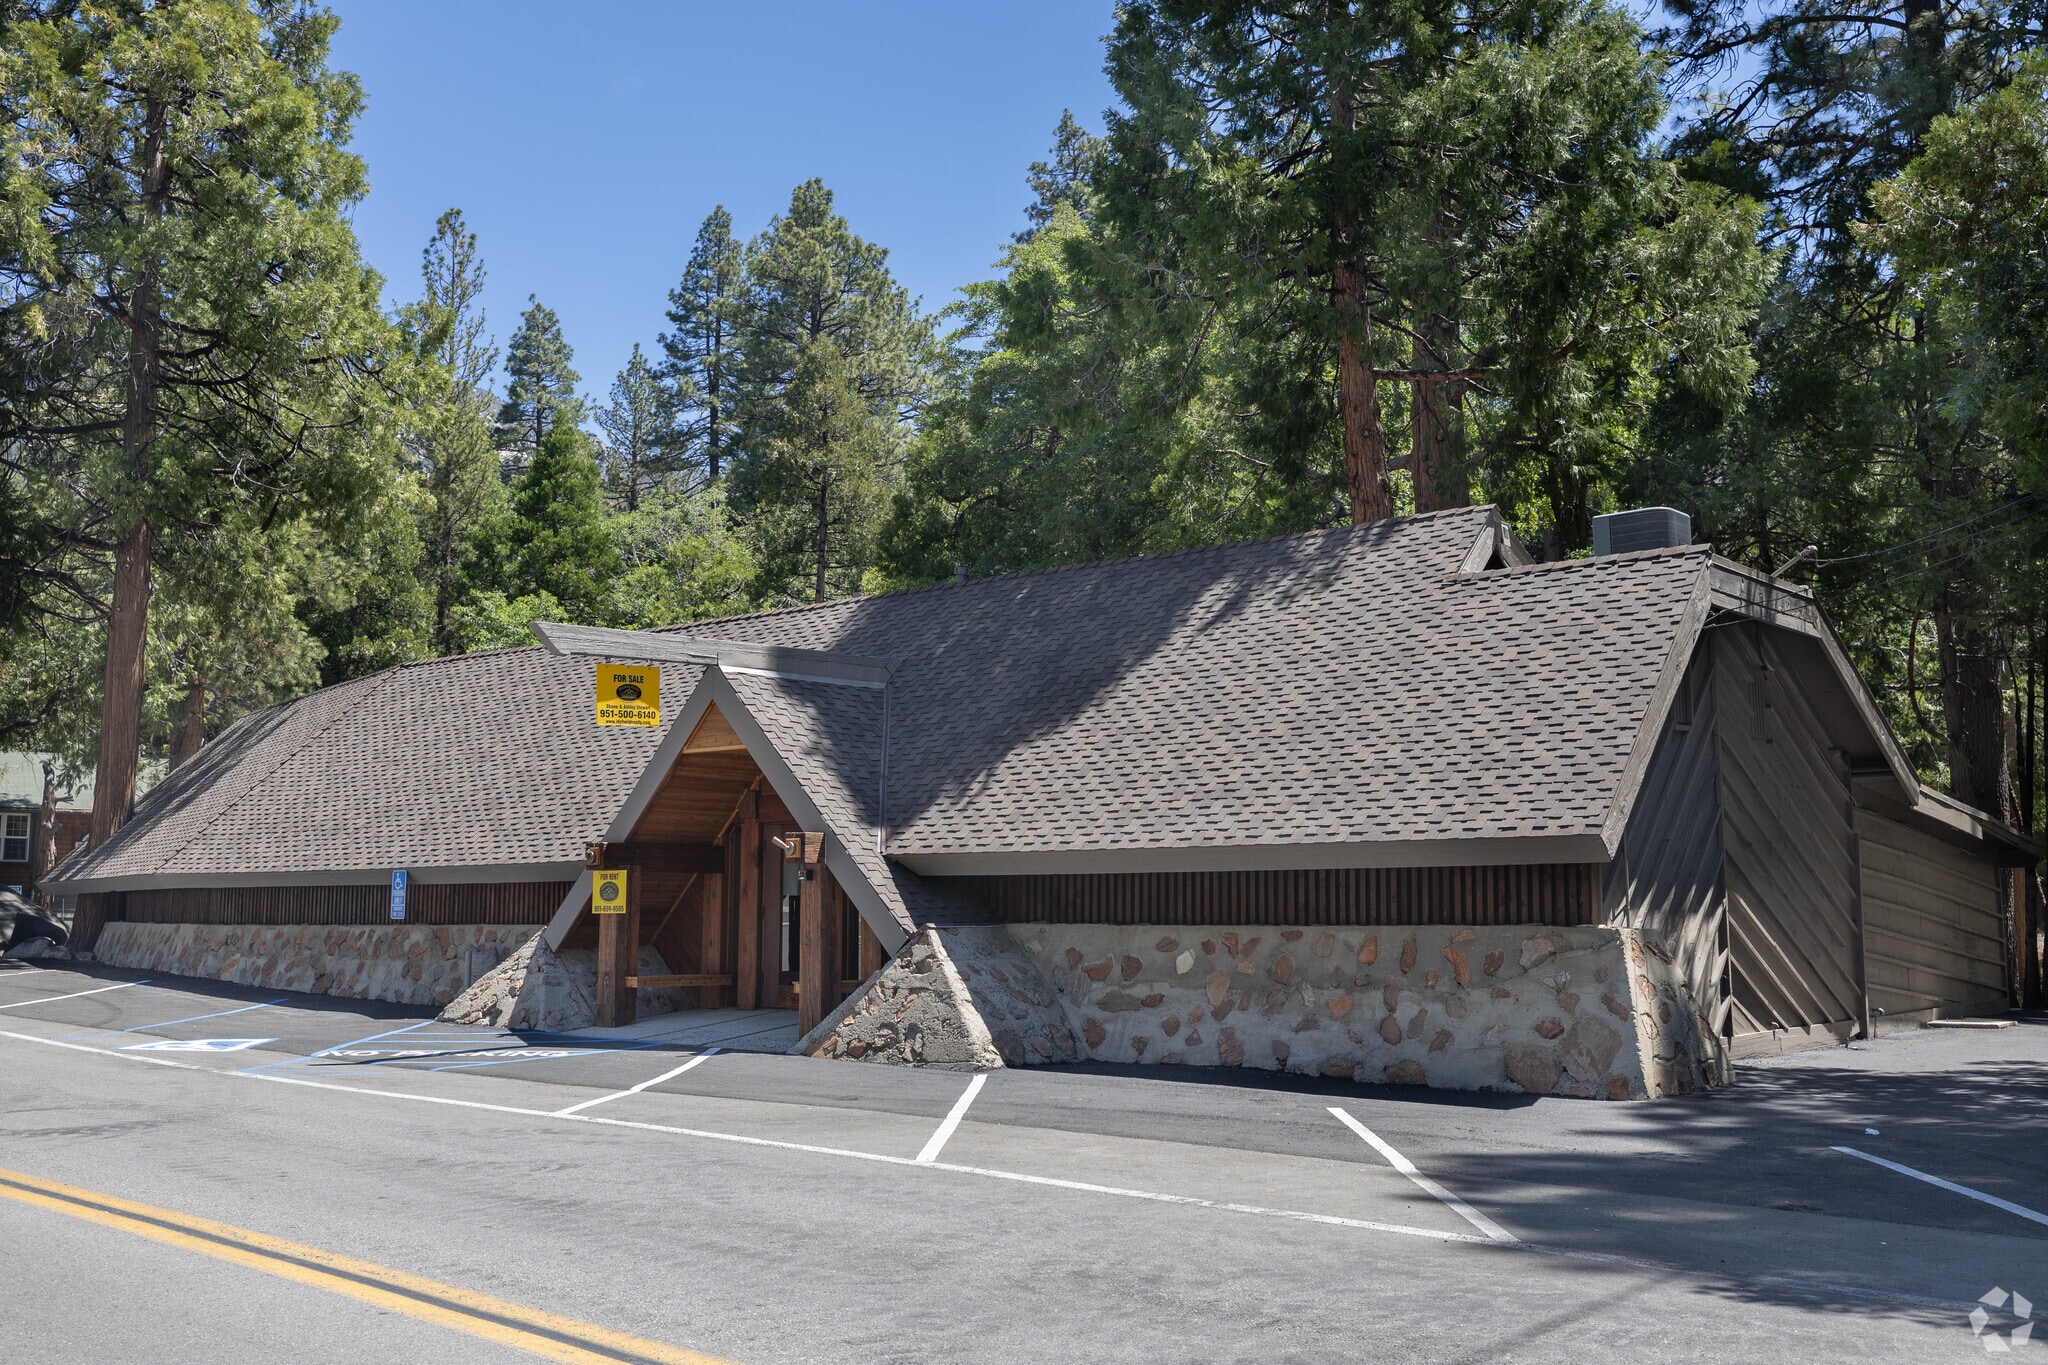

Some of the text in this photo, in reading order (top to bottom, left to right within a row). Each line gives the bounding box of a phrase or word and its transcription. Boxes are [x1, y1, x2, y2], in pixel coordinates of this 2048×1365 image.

[613, 674, 644, 683] FOR SALE
[600, 709, 656, 719] 951-500-6140
